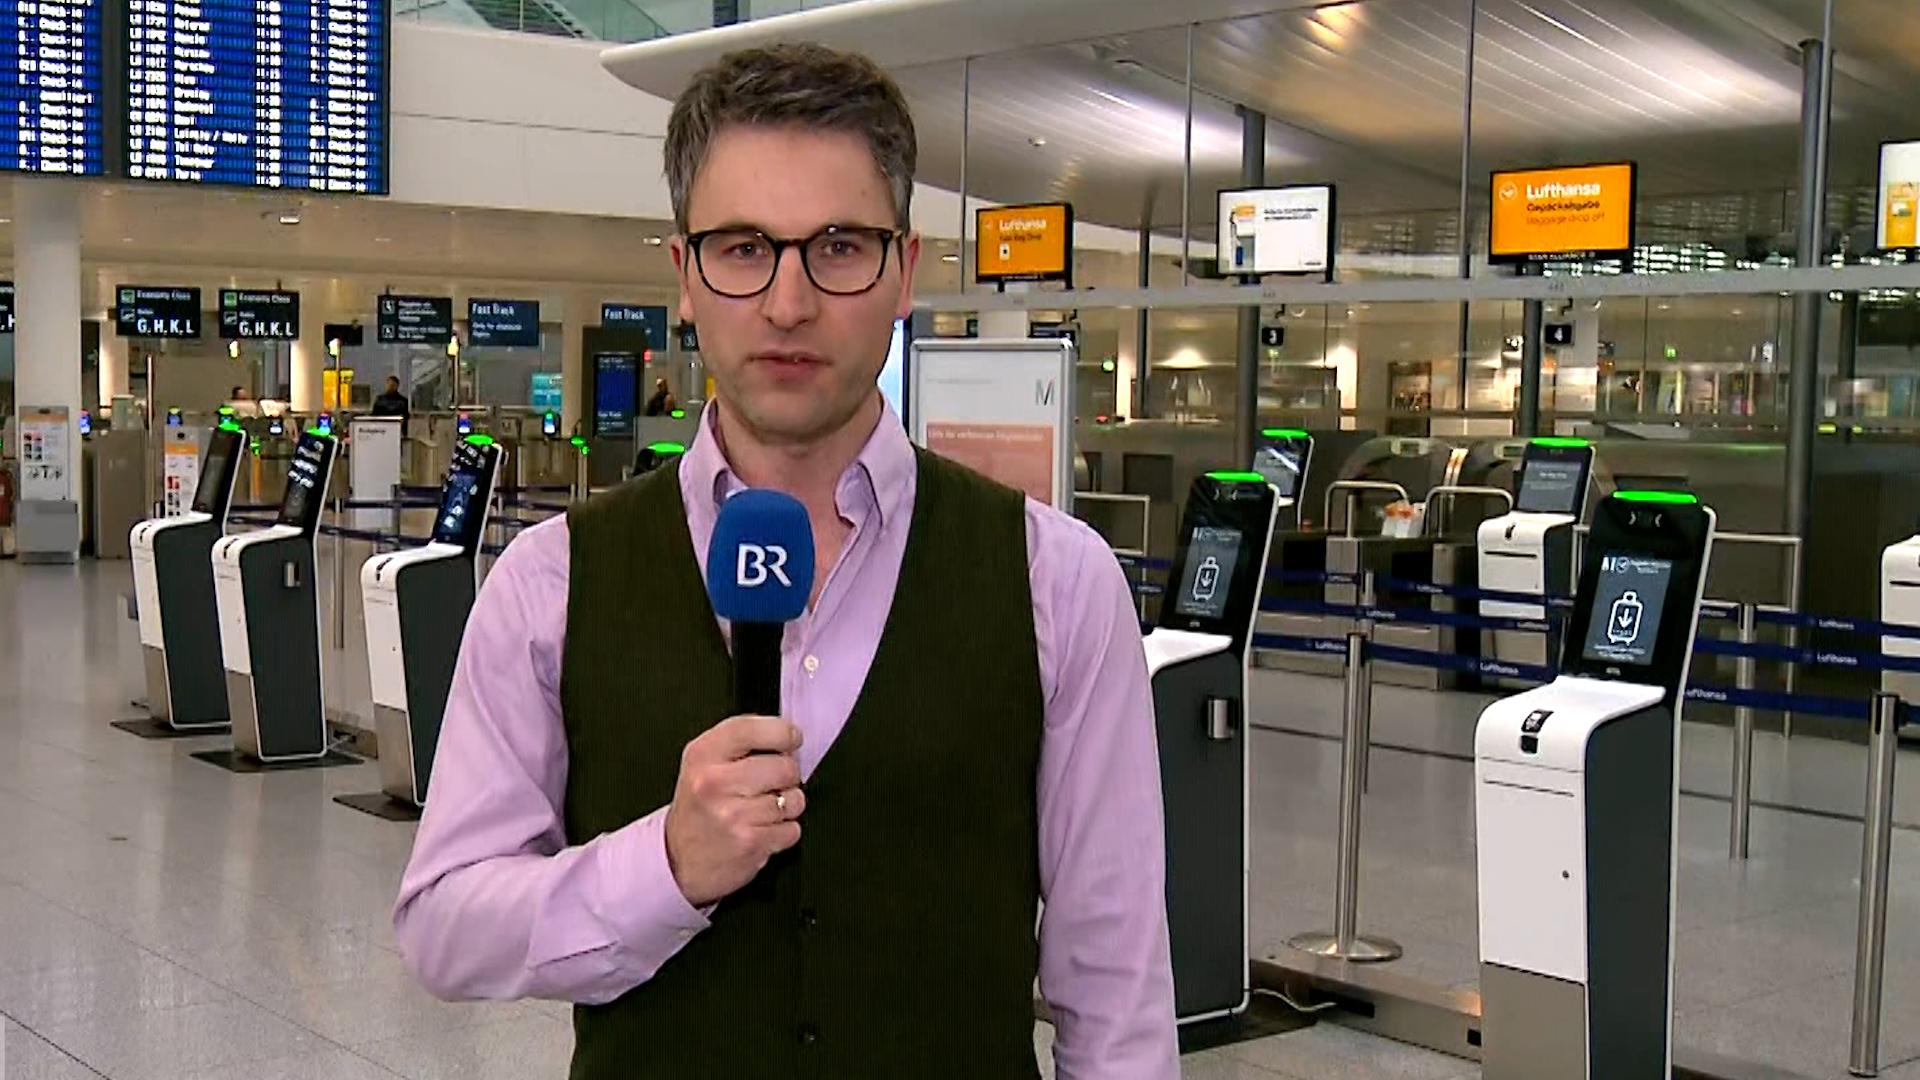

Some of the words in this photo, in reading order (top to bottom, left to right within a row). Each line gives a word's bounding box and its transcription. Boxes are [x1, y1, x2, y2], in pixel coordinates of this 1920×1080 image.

[1526, 183, 1601, 200] Lufthansa
[999, 218, 1047, 231] Lufthansa
[472, 303, 491, 315] Fast
[604, 308, 623, 319] Fast
[624, 308, 645, 320] Track
[1269, 329, 1278, 344] 3
[1553, 327, 1564, 342] 4
[736, 543, 792, 587] BR
[1818, 618, 1856, 631] Lufthansa
[1817, 653, 1858, 666] Lufthansa
[1479, 661, 1520, 676] Lufthansa
[1685, 688, 1728, 702] ufthansa
